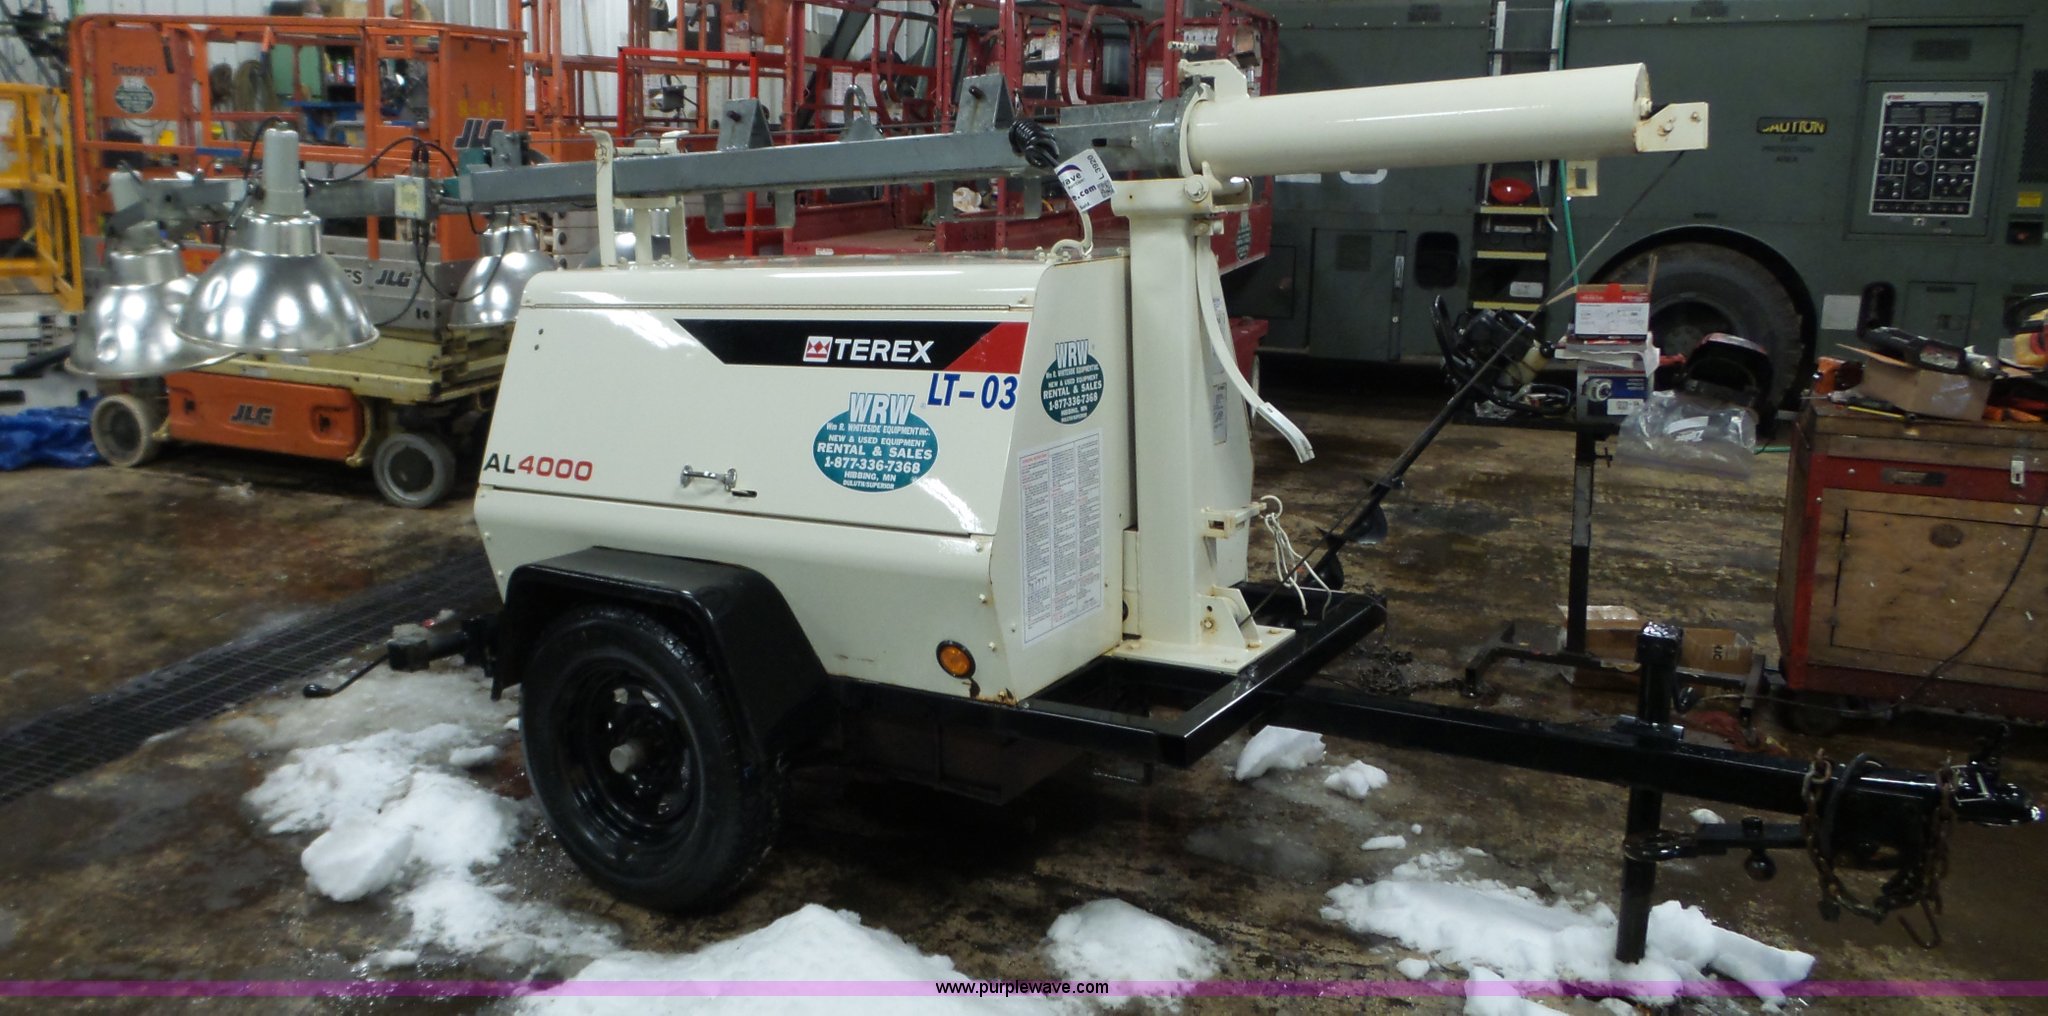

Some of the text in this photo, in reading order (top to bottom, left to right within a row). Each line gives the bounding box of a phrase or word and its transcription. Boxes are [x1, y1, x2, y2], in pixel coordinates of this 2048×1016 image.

[375, 269, 412, 288] JLG
[835, 339, 934, 364] TEREX
[1055, 339, 1088, 368] WRW
[927, 373, 1018, 410] LT-03
[1043, 380, 1102, 399] RENTAL & SALES
[849, 392, 915, 426] WRW
[1049, 392, 1098, 411] 1-877-336-7368
[229, 403, 274, 427] JLG
[848, 424, 881, 433] WHITESIDE
[828, 434, 846, 442] NEW
[881, 438, 926, 448] EQUIPMENT
[817, 442, 933, 460] RENTAL & SALES
[483, 452, 593, 482] AL4000
[824, 456, 920, 474] 1-877-336-7368
[844, 471, 897, 482] HIBBING, MN
